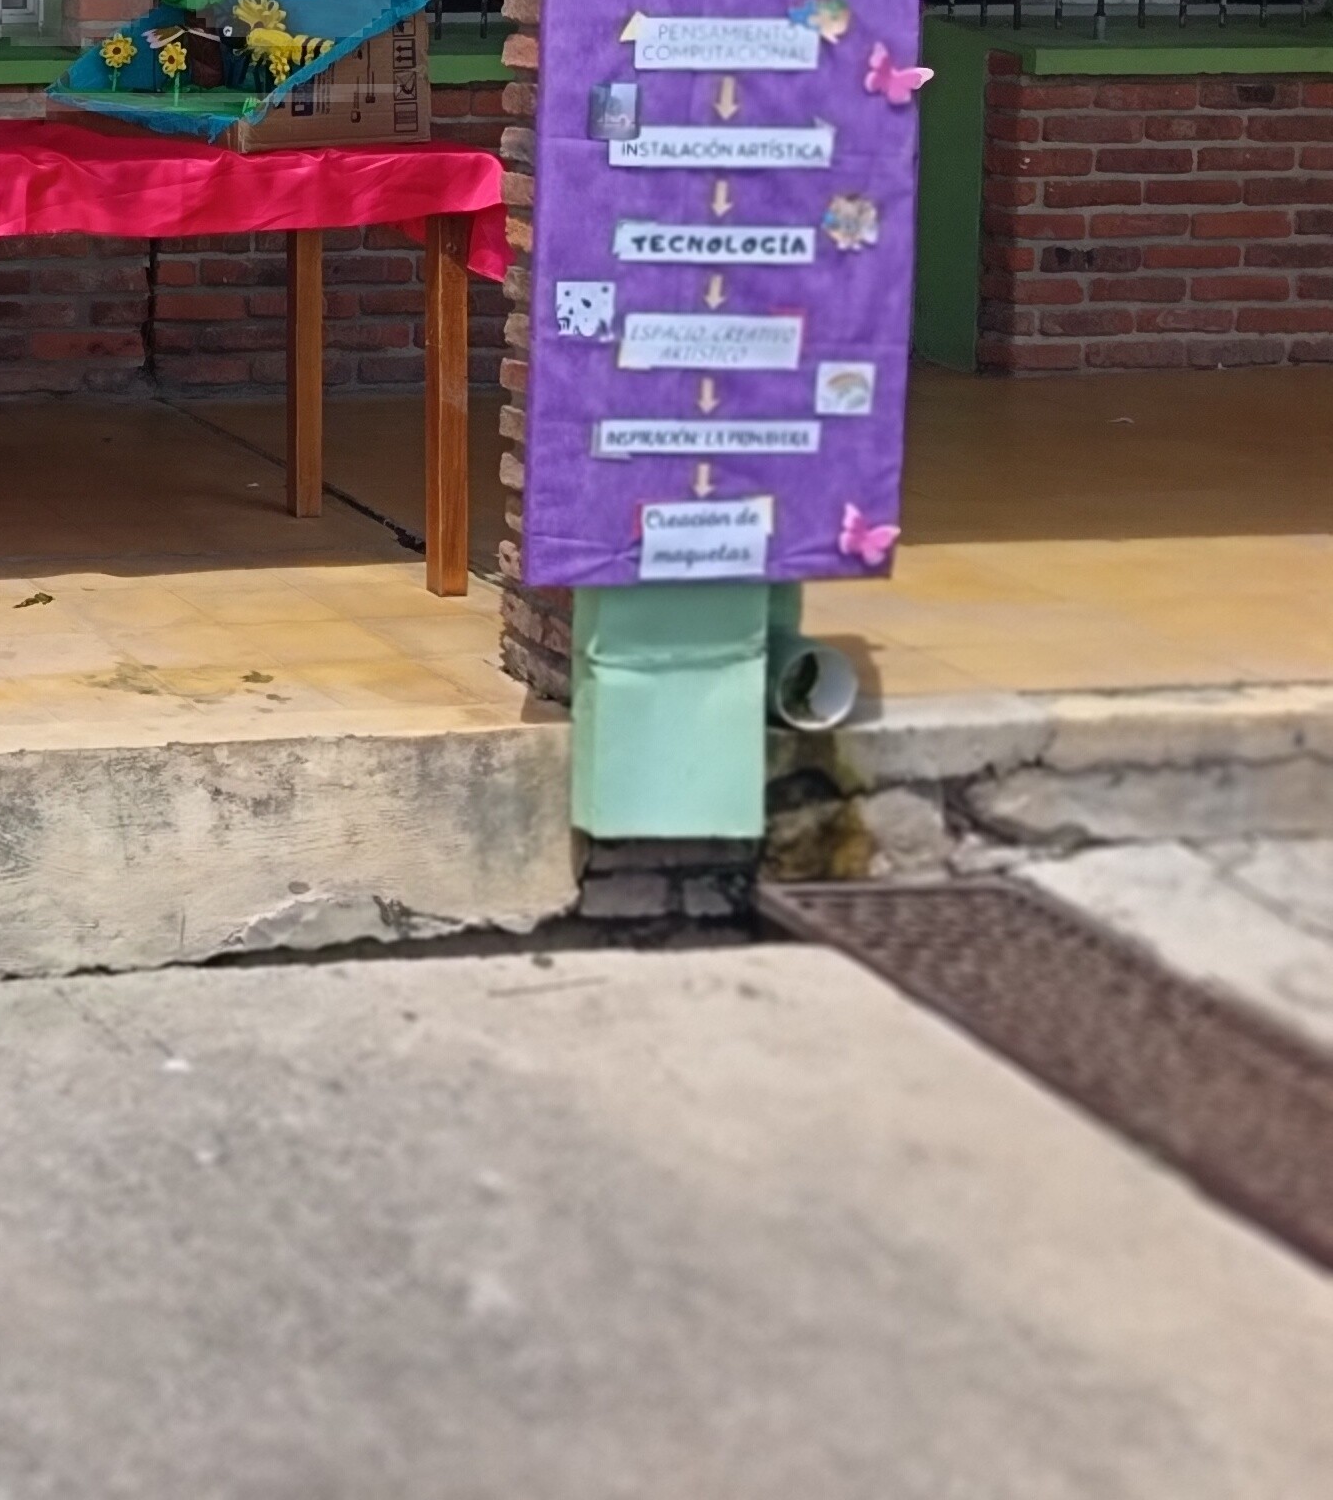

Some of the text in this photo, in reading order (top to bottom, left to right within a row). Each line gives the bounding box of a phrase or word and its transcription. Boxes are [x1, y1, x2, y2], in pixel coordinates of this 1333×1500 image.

[658, 24, 800, 41] PENSAMIENTO
[621, 138, 824, 159] INSTALACIÓN ARTÍSTICA
[631, 233, 808, 256] TECNOLOGÍA
